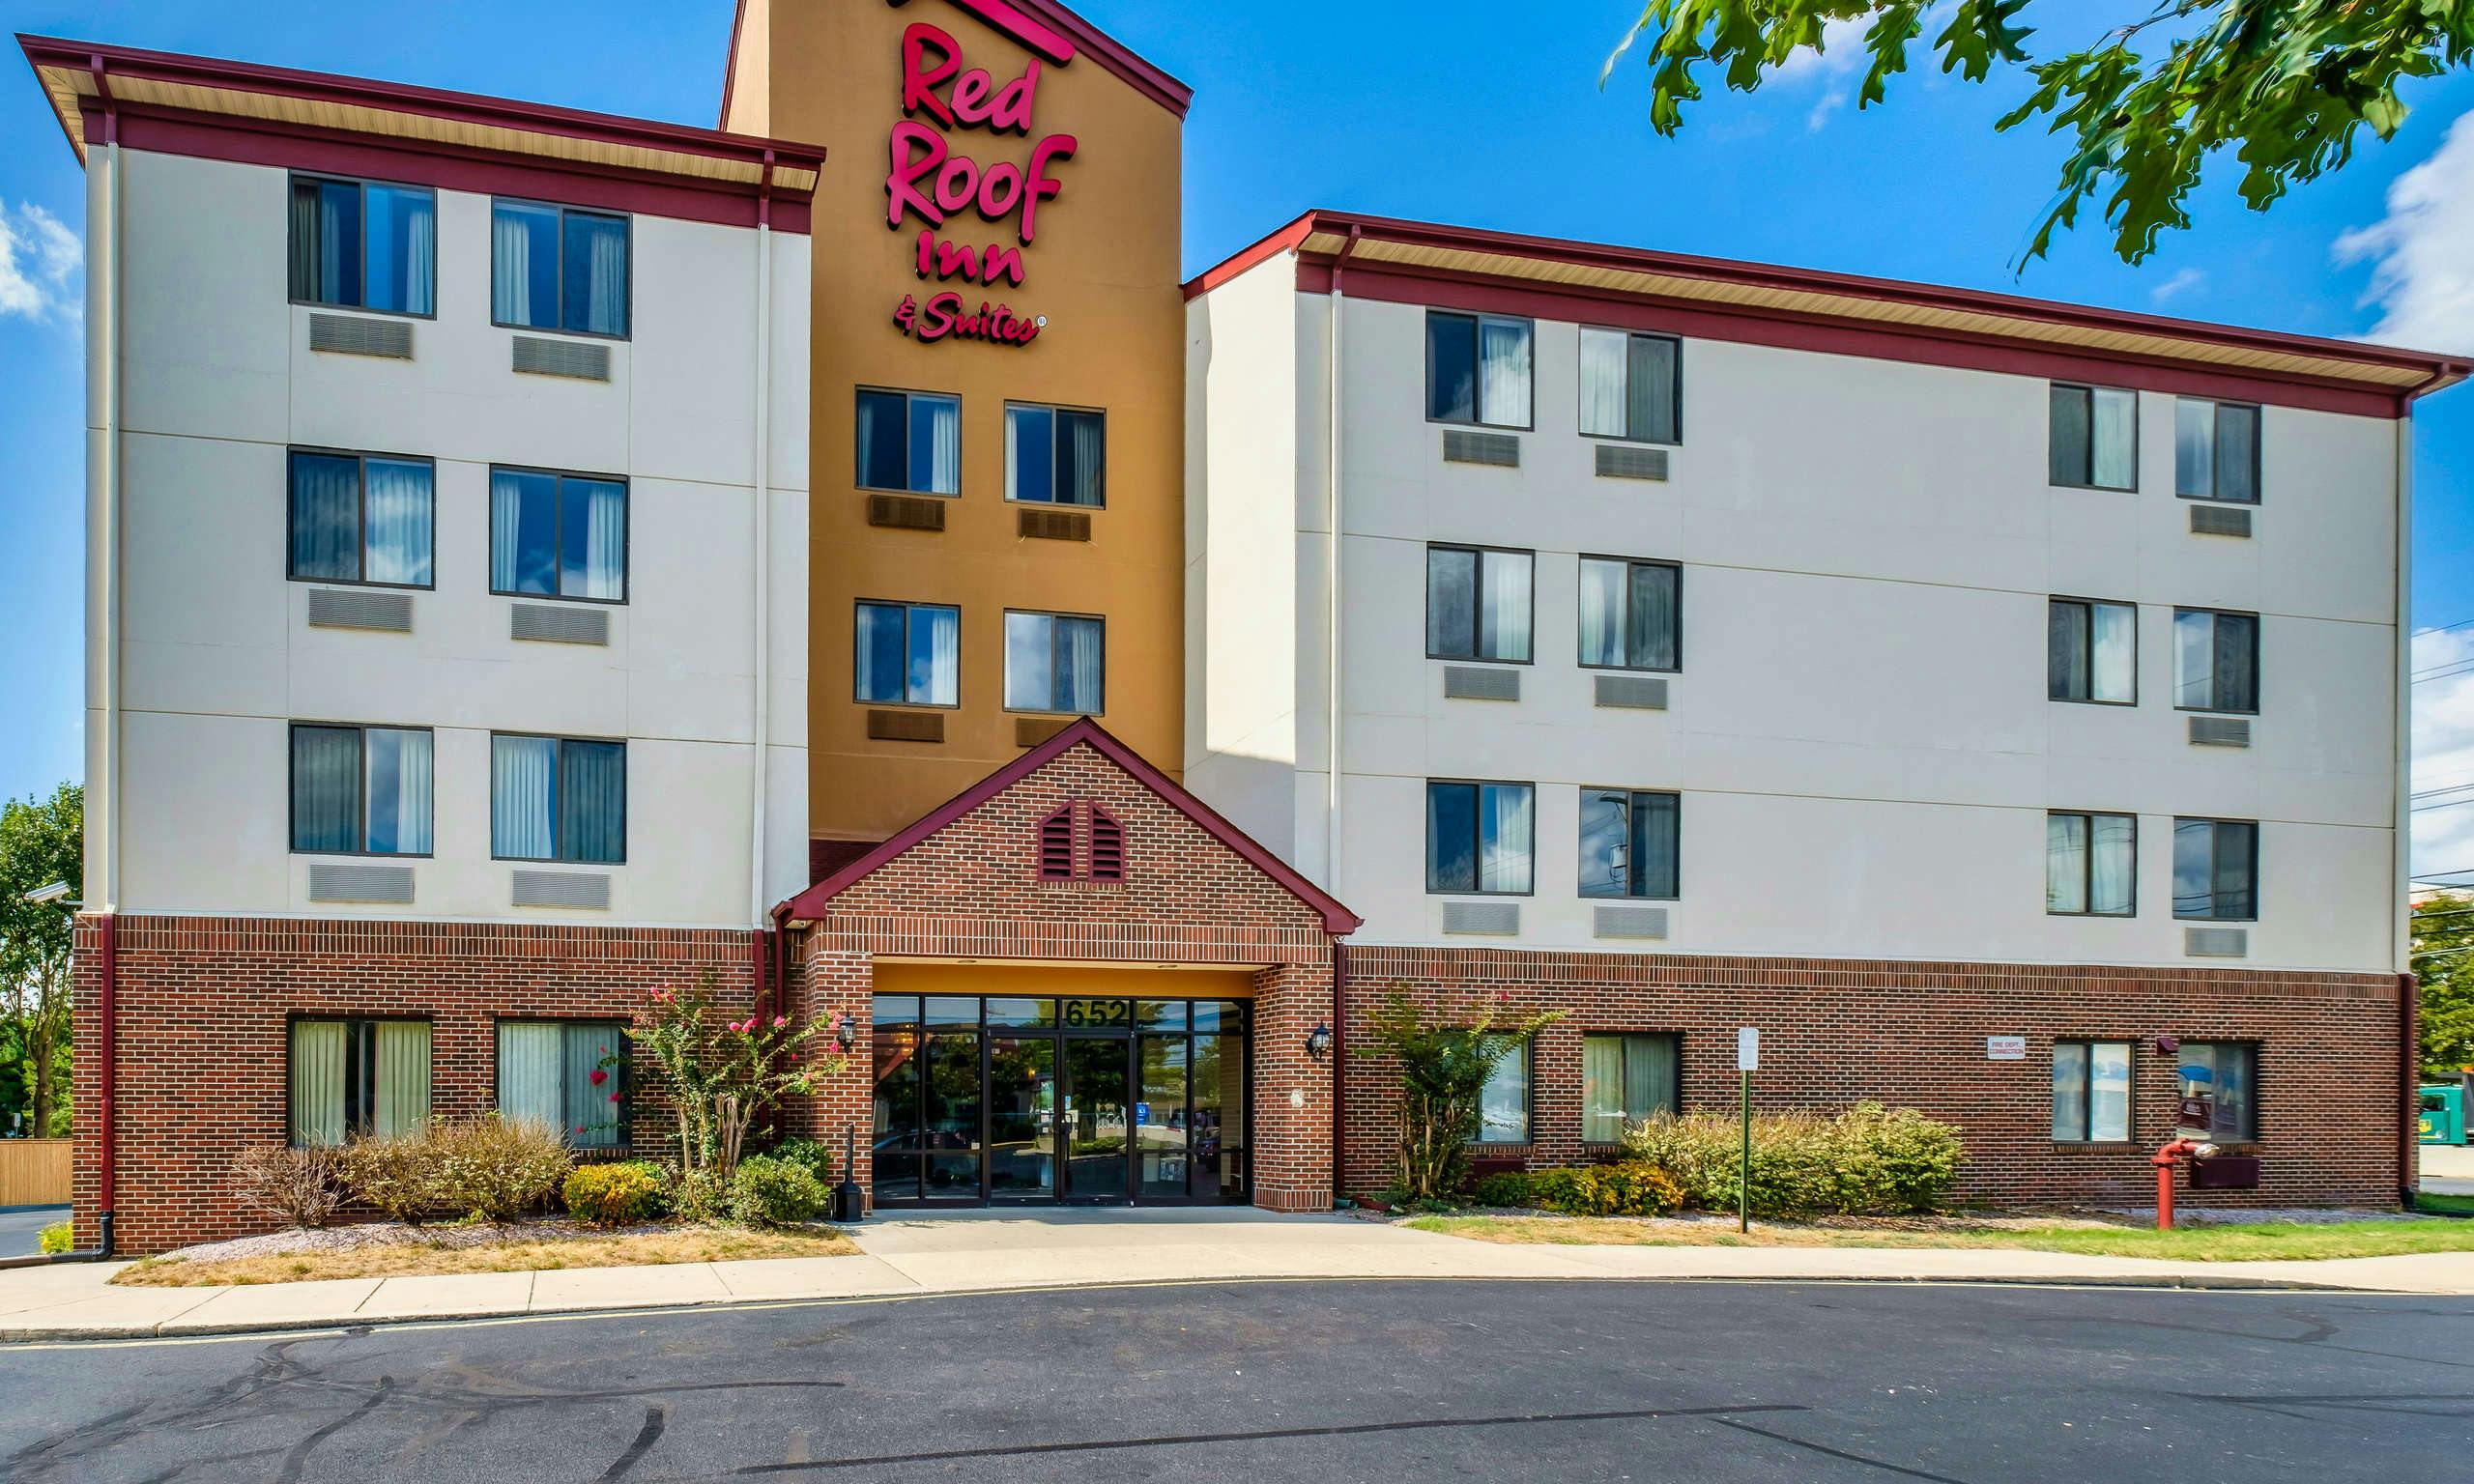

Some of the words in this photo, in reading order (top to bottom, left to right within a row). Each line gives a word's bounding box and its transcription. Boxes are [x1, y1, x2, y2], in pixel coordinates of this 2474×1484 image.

[903, 22, 1041, 135] Red
[885, 121, 1078, 246] Roof
[917, 230, 1024, 288] Inn
[894, 294, 916, 335] &
[918, 292, 1040, 347] Suites
[1066, 1000, 1127, 1027] 652
